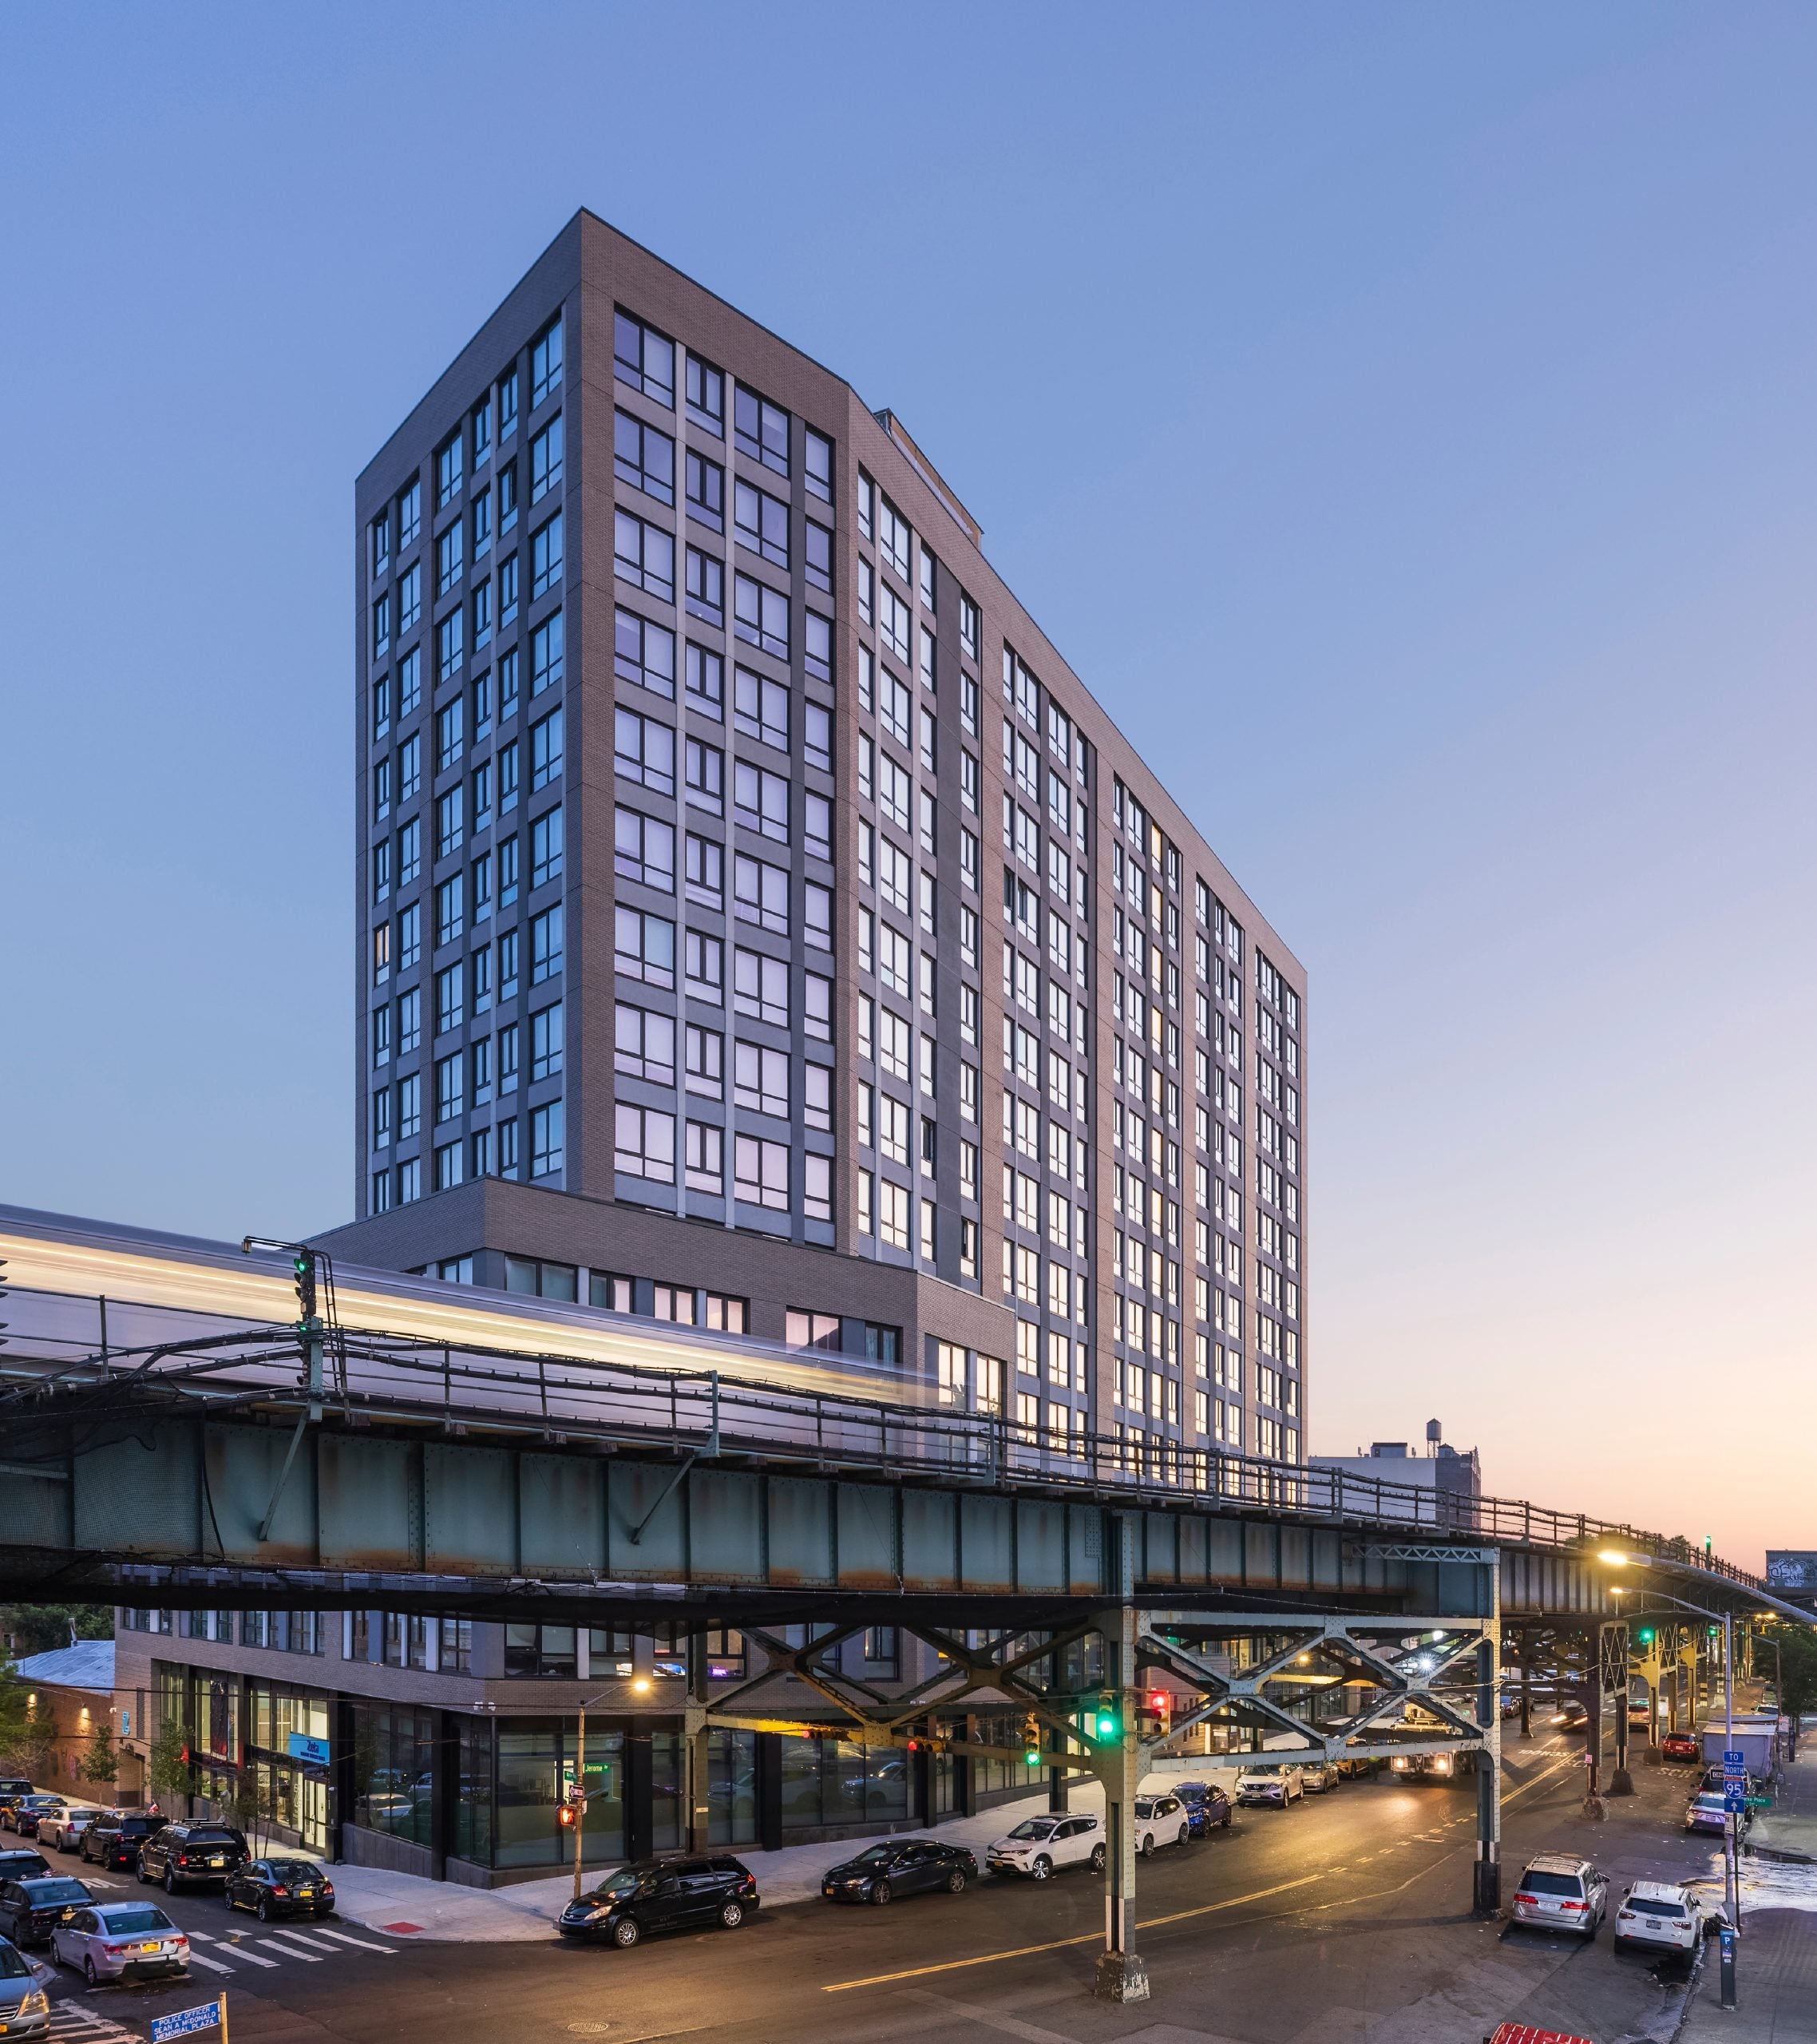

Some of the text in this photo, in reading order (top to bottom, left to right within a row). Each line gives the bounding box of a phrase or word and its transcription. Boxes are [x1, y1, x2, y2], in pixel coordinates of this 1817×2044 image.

[1724, 1765, 1744, 1774] NORTH
[1726, 1783, 1741, 1796] 95
[1724, 1936, 1731, 1945] P
[160, 2006, 211, 2026] POLICE OFFICER
[154, 2023, 173, 2035] SEAN
[156, 2018, 215, 2041] MEMORIAL PLAZA
